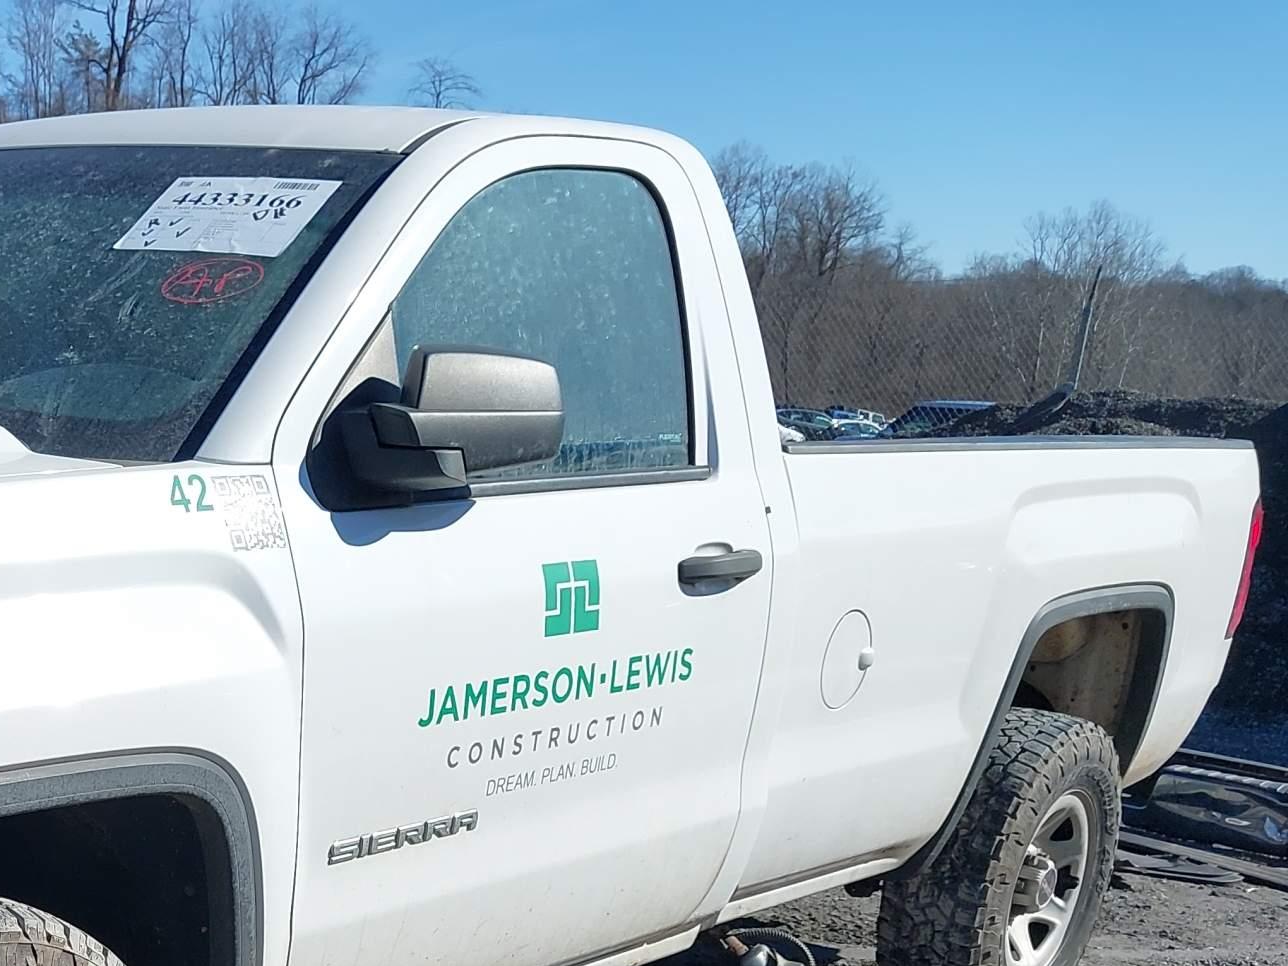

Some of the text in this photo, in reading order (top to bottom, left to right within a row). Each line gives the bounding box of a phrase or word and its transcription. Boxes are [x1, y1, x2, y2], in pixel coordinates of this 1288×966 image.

[172, 192, 307, 209] 44333166
[170, 474, 214, 512] 42
[447, 707, 663, 769] CONSTRUCTION
[486, 753, 618, 797] DREAM. PLAN. BUILD.
[328, 808, 479, 866] SIERRA
